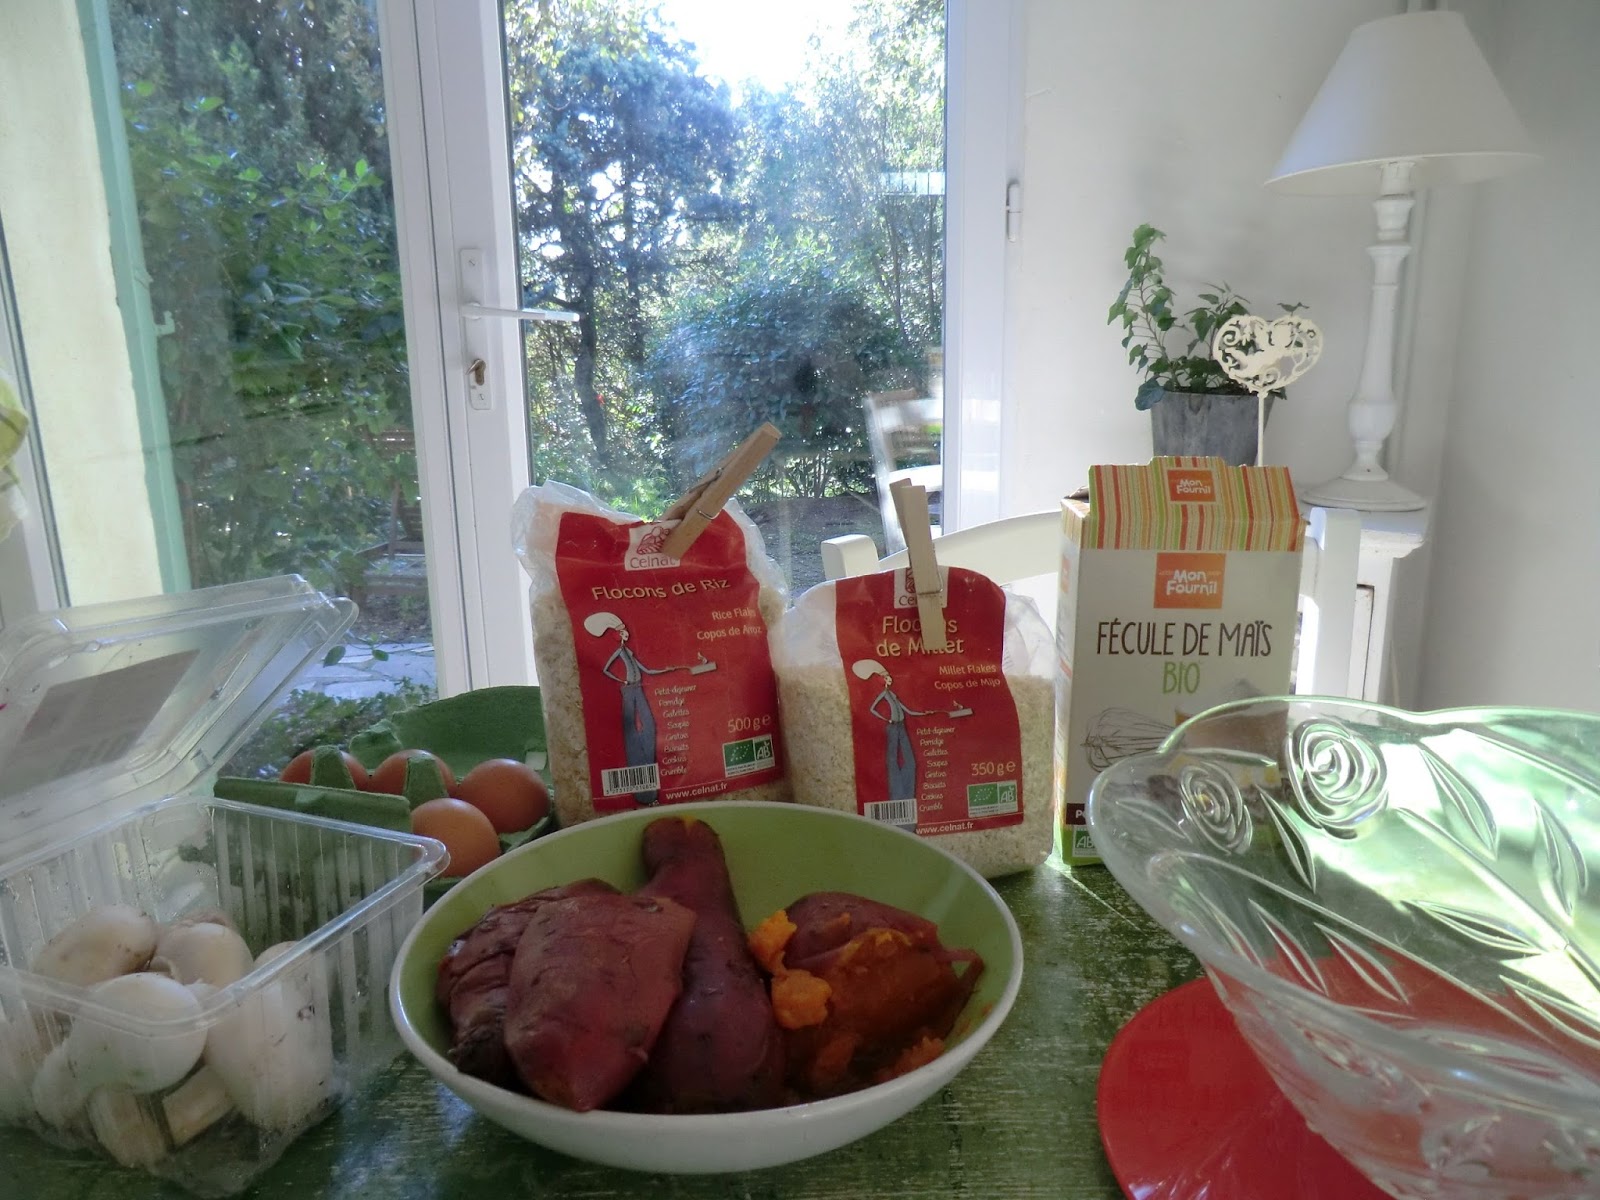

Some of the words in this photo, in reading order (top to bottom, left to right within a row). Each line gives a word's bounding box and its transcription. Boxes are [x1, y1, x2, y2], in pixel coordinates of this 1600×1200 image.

[1176, 485, 1211, 495] Fournil
[1179, 478, 1203, 487] Mon
[1173, 569, 1207, 583] Mon
[591, 586, 667, 600] Flocons
[671, 581, 697, 596] de
[700, 578, 731, 591] Riz
[1166, 580, 1217, 596] Fournil
[711, 610, 733, 620] Rice
[882, 615, 958, 634] Flocs
[696, 628, 727, 641] Copos
[728, 626, 741, 636] de
[1096, 617, 1176, 656] FÉCULE
[1181, 622, 1212, 656] DE
[1218, 620, 1273, 657] MAÏS
[876, 639, 901, 657] de
[908, 638, 965, 656] Met
[939, 664, 966, 675] Millet
[967, 664, 997, 674] Flakes
[934, 679, 964, 691] Copos
[965, 679, 979, 687] de
[981, 677, 1001, 689] Mijo
[1162, 661, 1200, 695] BIO
[665, 783, 728, 800] www.celnat.fr
[915, 821, 975, 835] www.celnat.fr
